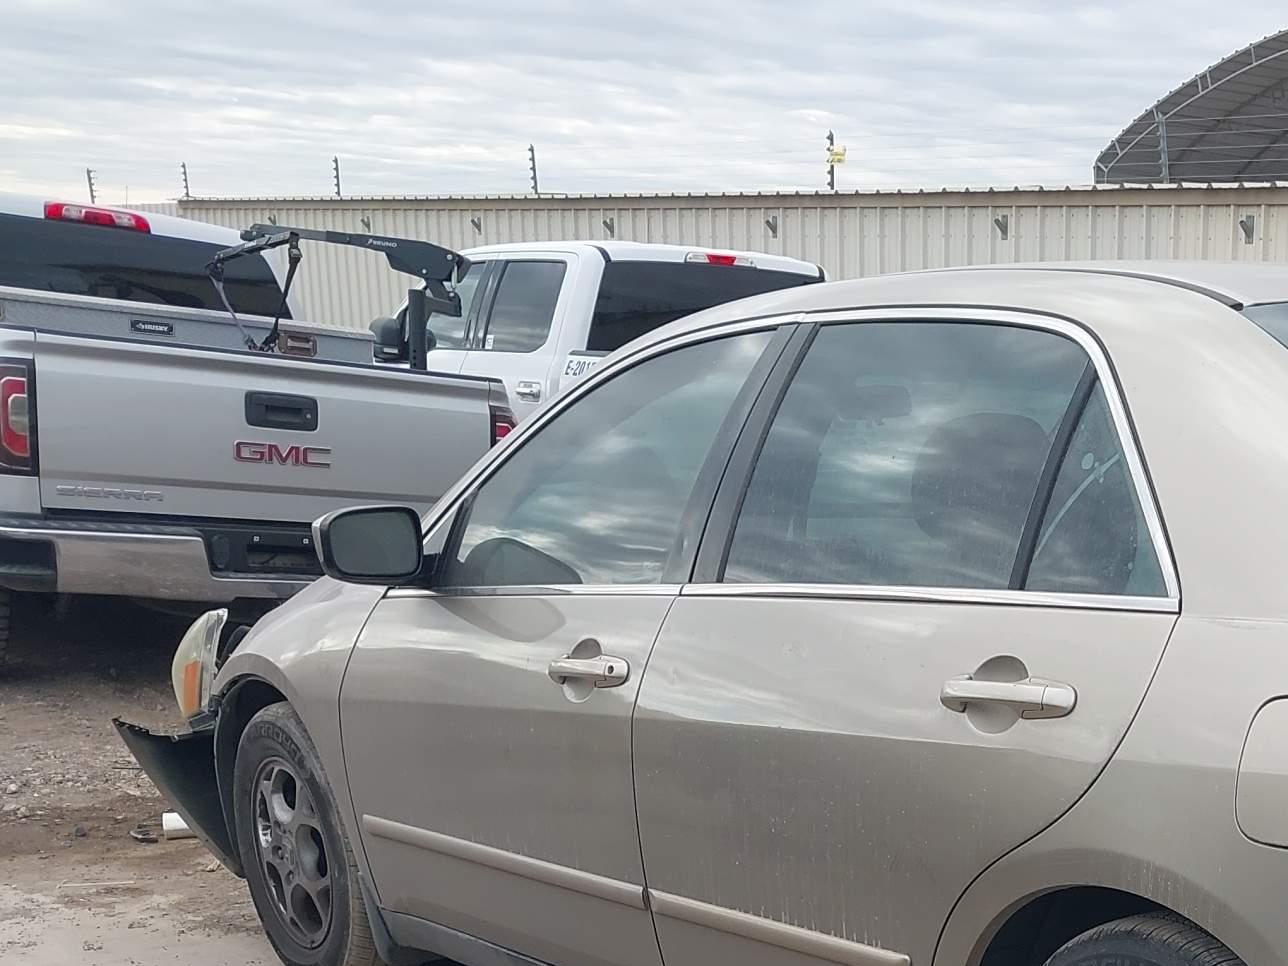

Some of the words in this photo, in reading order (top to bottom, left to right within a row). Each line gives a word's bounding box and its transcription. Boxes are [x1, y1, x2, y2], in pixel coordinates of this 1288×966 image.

[565, 360, 597, 376] E-201
[233, 439, 332, 468] GMC
[56, 485, 163, 502] SIERRA
